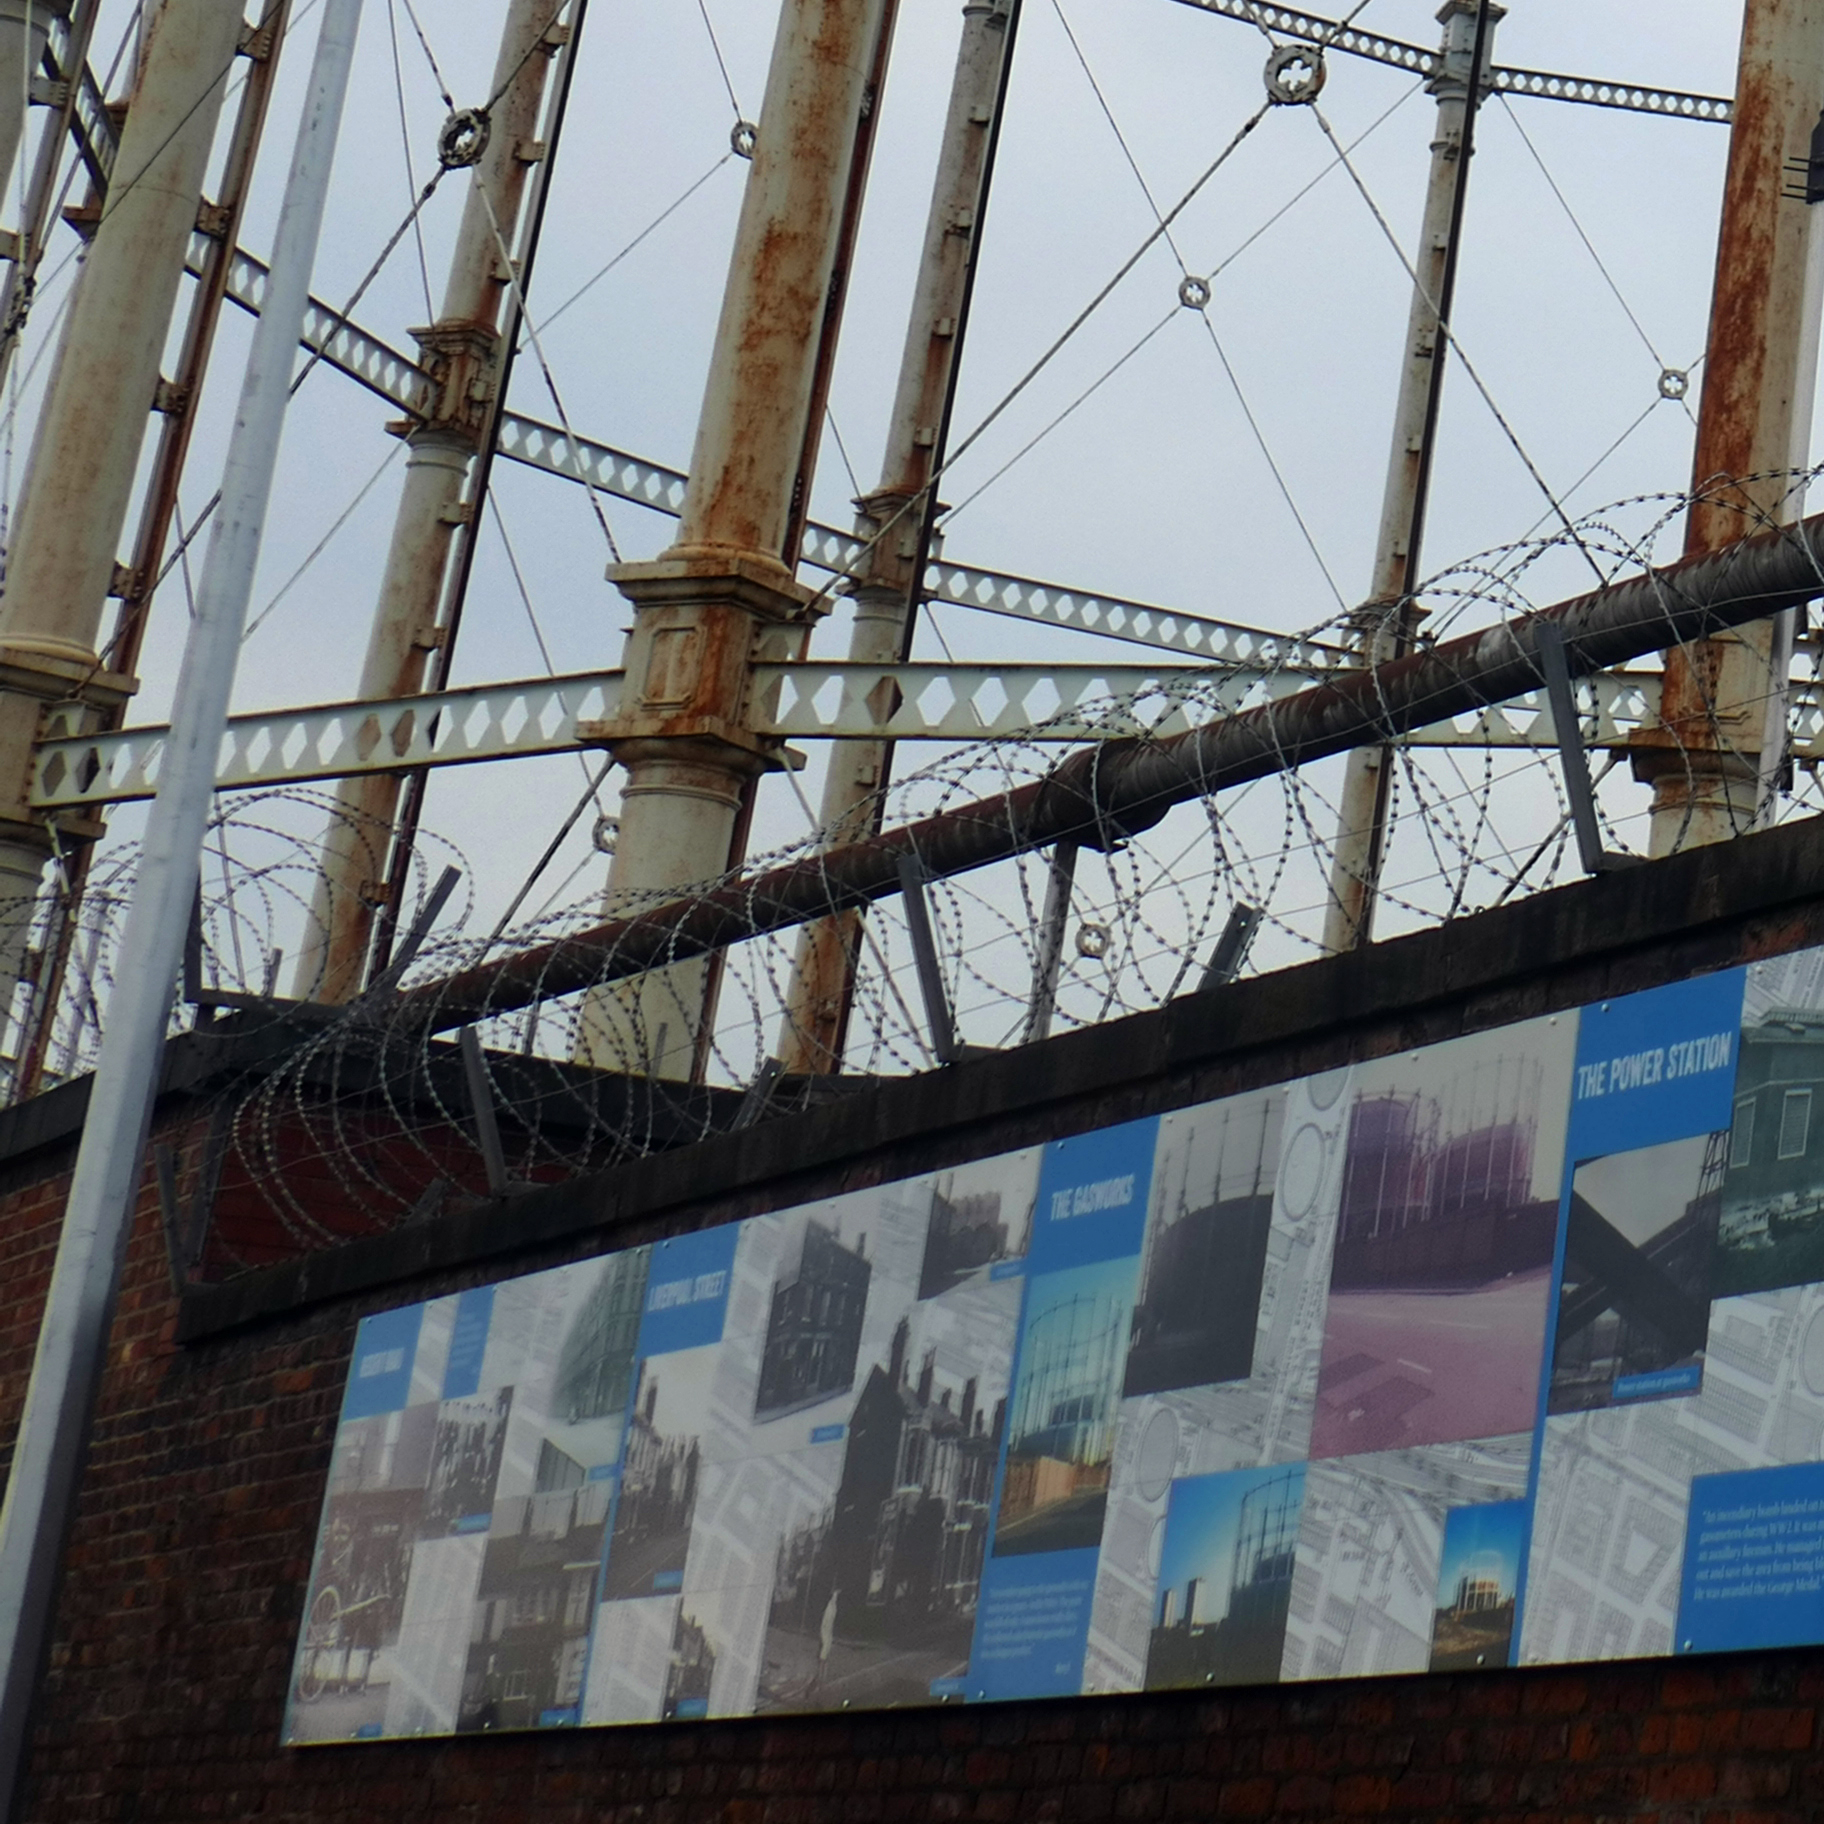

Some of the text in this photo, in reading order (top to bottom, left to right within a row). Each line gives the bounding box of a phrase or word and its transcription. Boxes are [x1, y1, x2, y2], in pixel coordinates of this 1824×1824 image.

[1578, 1031, 1732, 1100] THE POWER STATION
